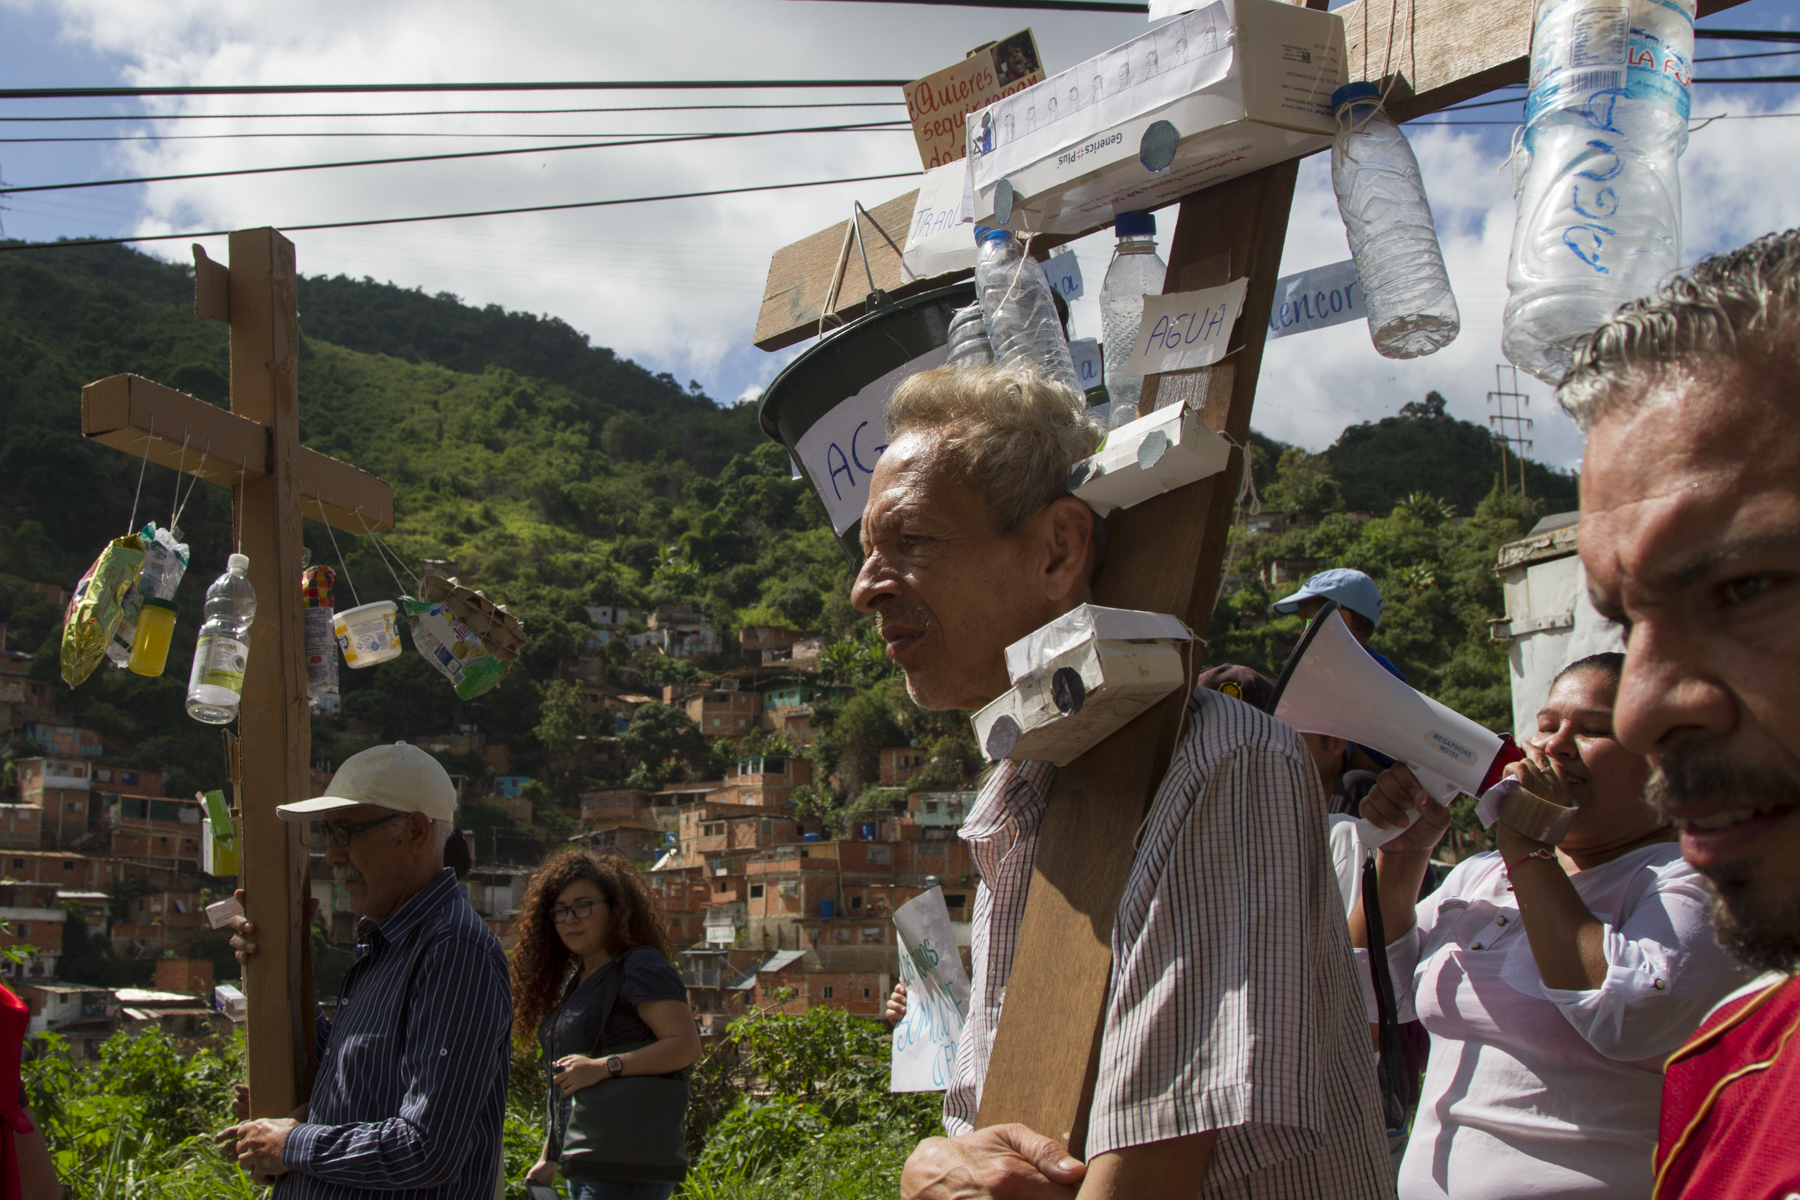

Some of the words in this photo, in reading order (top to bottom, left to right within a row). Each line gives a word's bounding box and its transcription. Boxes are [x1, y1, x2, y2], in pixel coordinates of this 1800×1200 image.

[1628, 46, 1655, 69] LA
[1085, 132, 1123, 154] Generics
[910, 202, 965, 241] TRAN
[1144, 302, 1227, 357] AGUA
[827, 420, 889, 501] AG
[1433, 732, 1473, 759] MEGAPHONE
[1439, 744, 1460, 759] MG105
